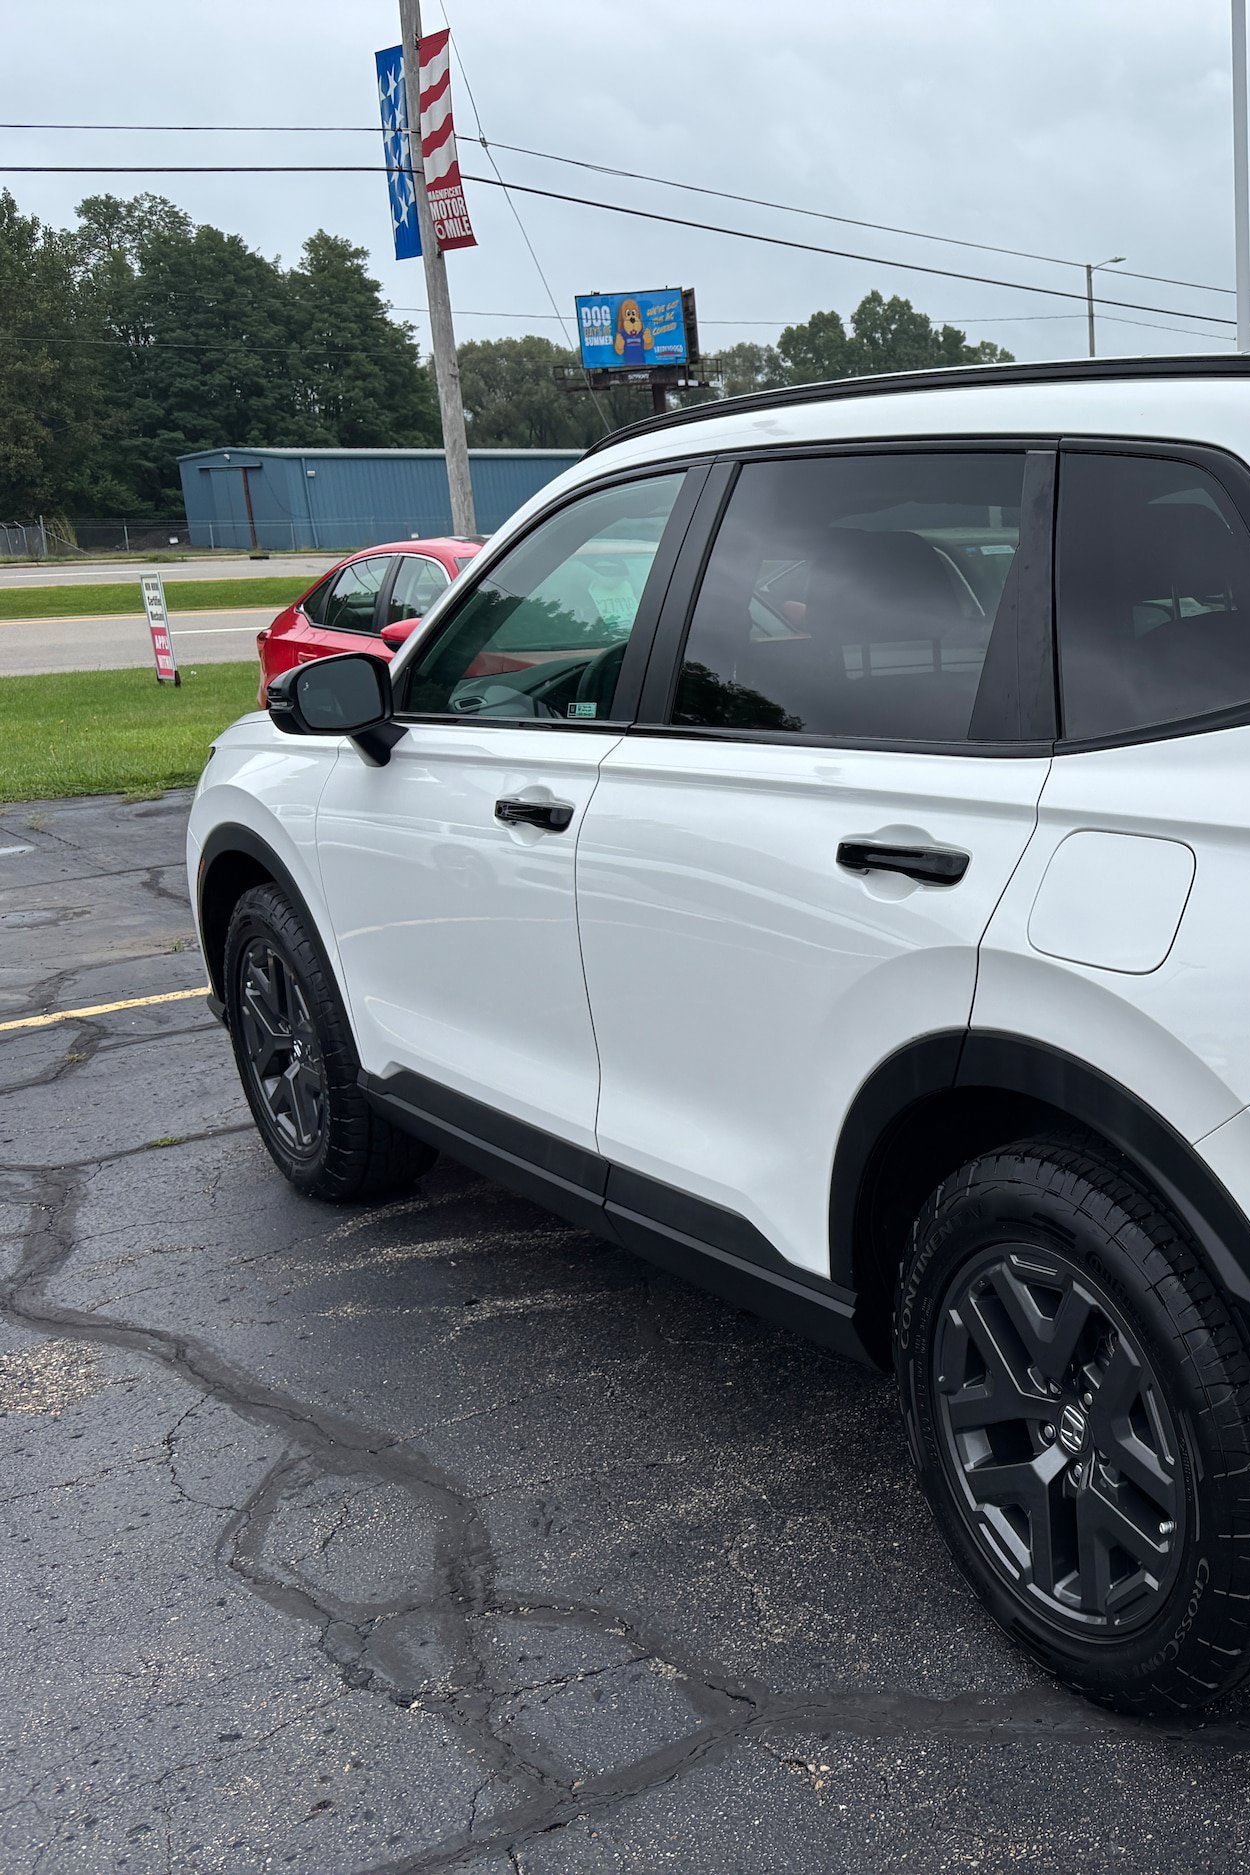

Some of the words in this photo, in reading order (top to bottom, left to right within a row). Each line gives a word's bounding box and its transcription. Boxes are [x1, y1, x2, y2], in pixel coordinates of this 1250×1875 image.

[427, 185, 462, 201] MAGNIFICENT
[429, 197, 467, 221] MOTOR
[444, 216, 472, 238] MILE
[581, 305, 611, 327] DOG
[584, 335, 613, 346] SUMMER
